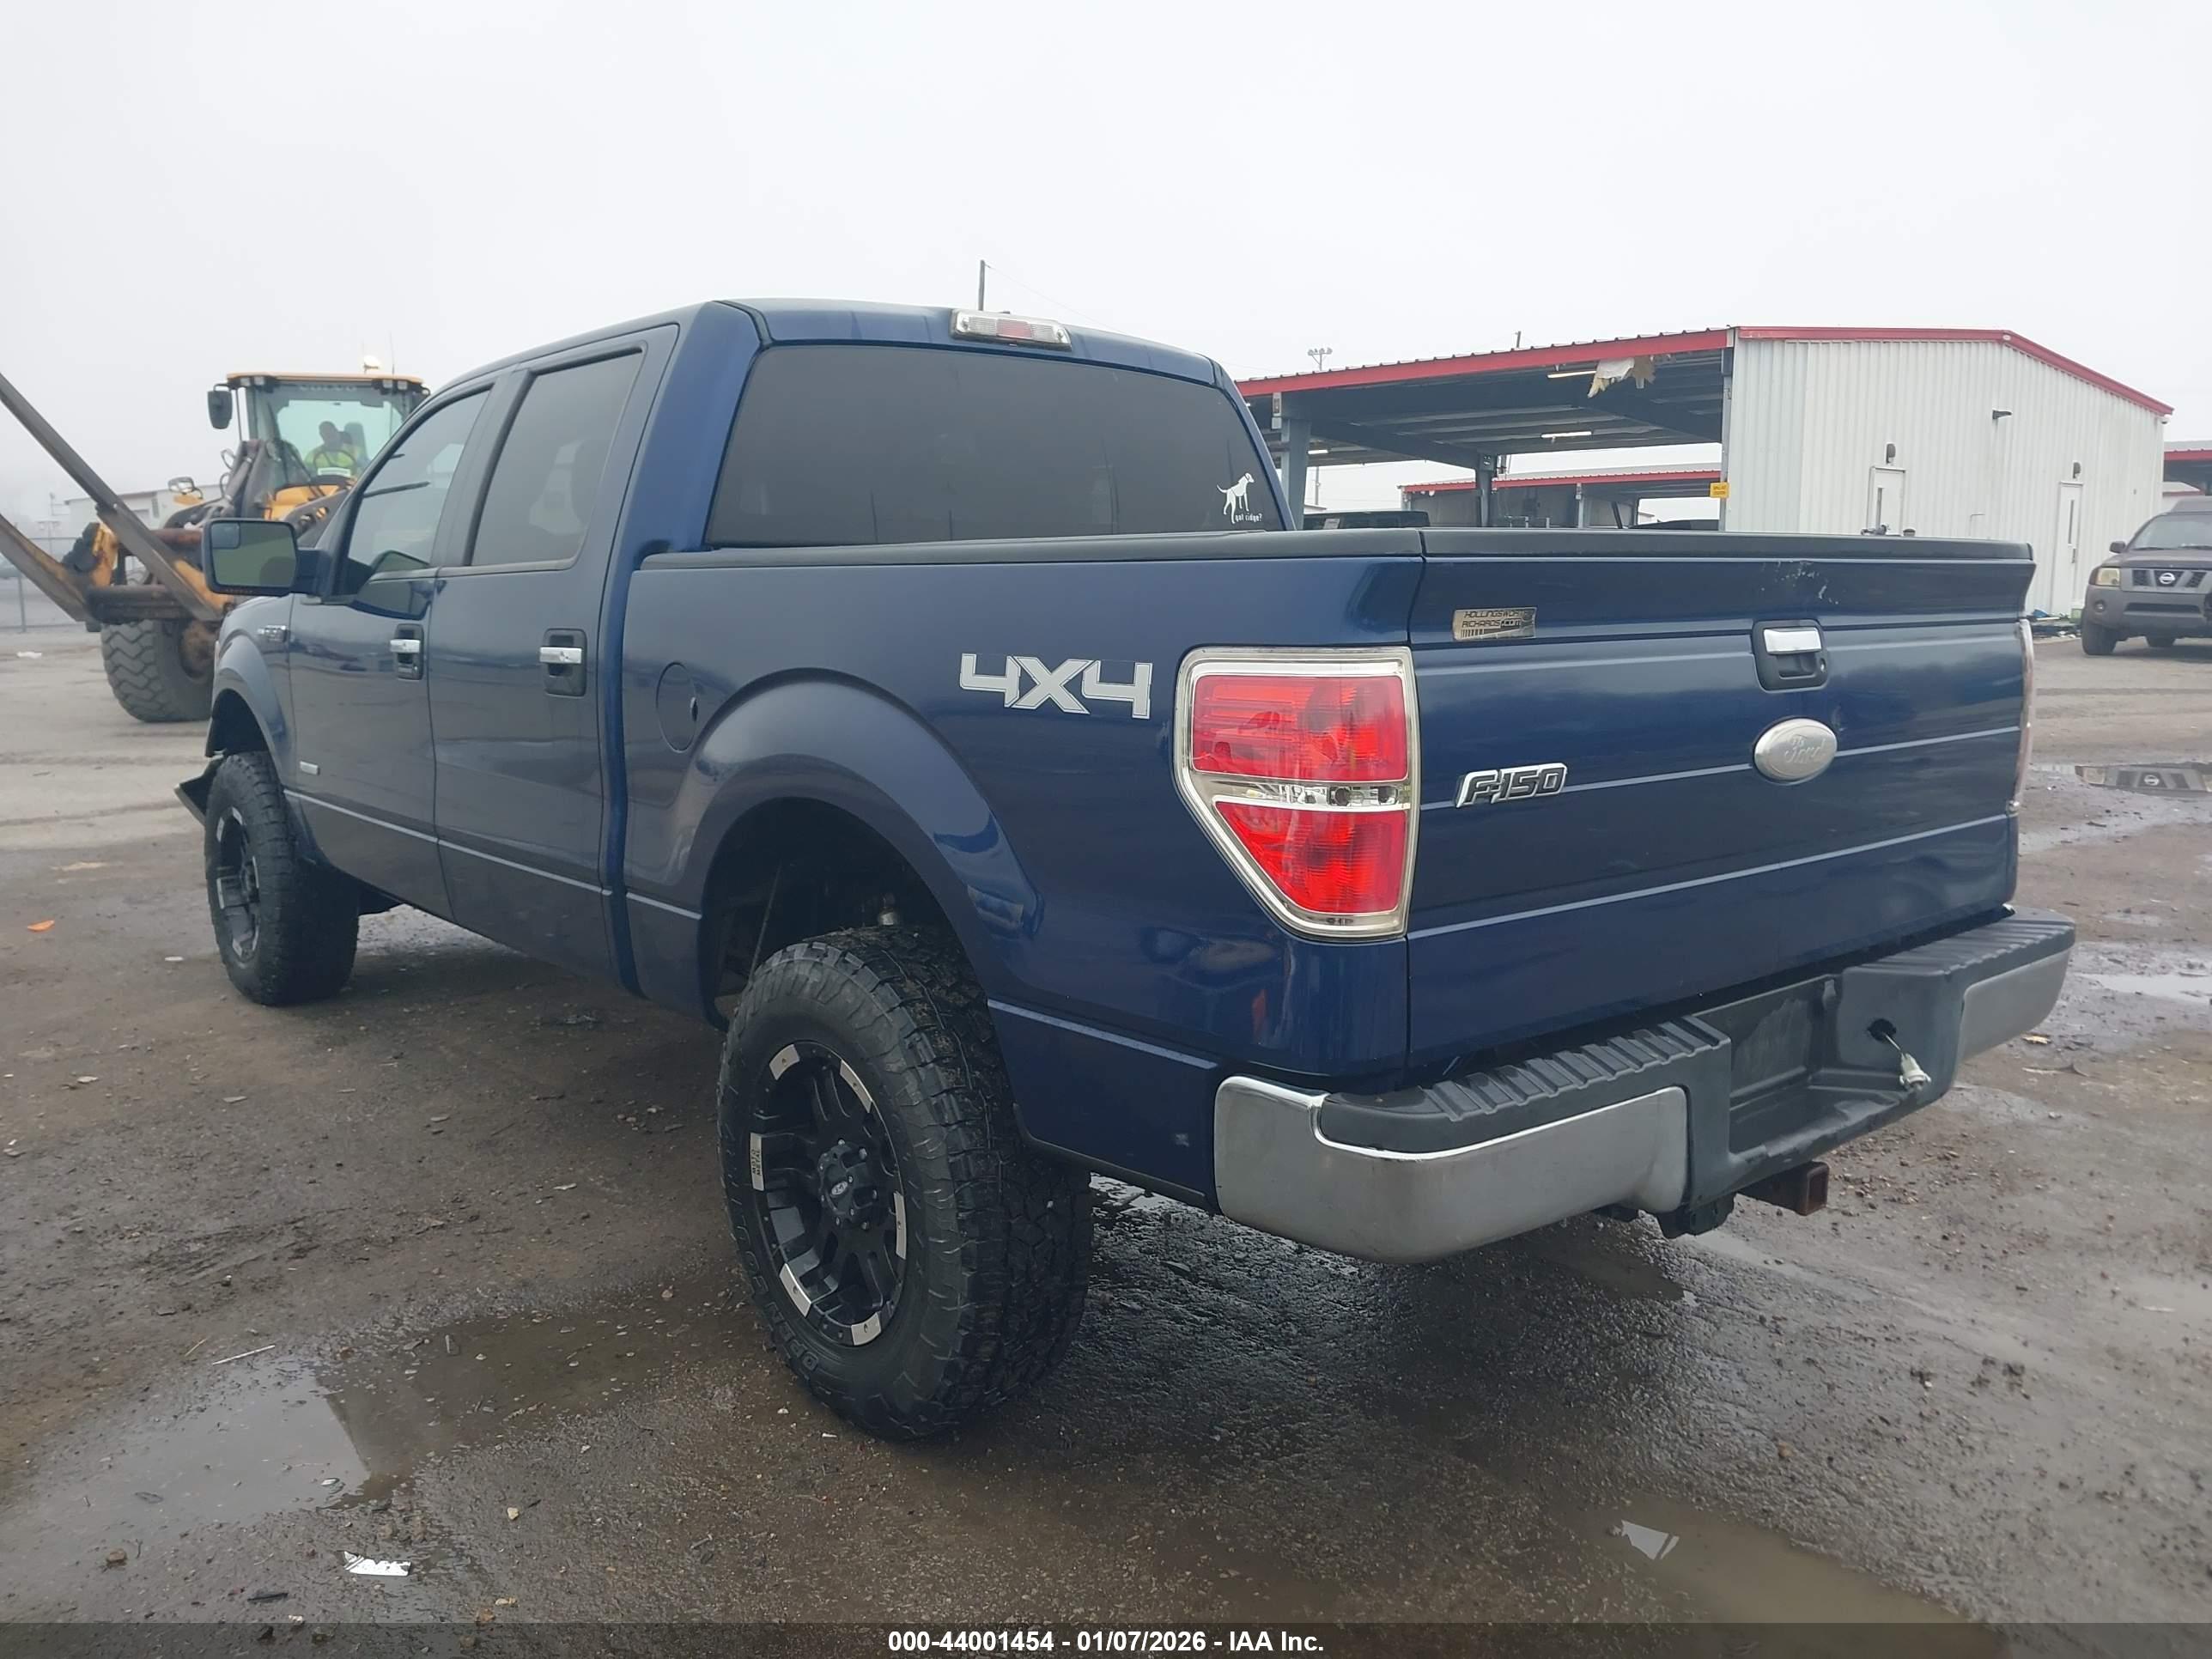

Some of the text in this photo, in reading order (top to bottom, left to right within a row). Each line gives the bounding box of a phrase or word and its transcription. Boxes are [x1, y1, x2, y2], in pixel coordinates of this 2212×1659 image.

[1784, 733, 1826, 764] Ford
[1455, 762, 1568, 809] F-150
[765, 1301, 819, 1371] OPEN
